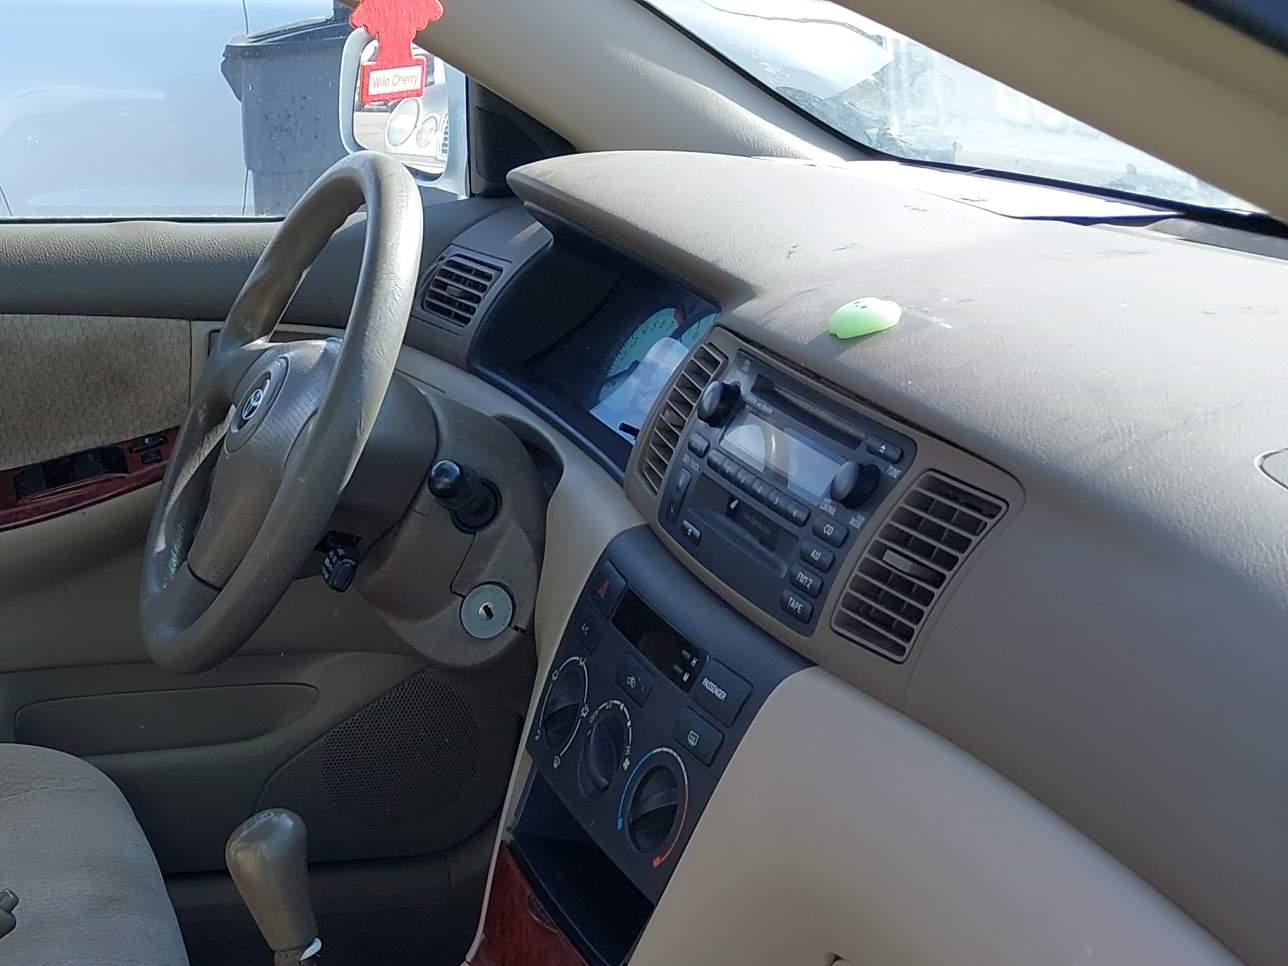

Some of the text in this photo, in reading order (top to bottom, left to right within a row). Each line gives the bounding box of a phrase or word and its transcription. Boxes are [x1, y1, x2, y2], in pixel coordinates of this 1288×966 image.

[372, 74, 418, 89] Wild Cherry
[823, 524, 834, 536] CD
[787, 596, 805, 614] TAPE
